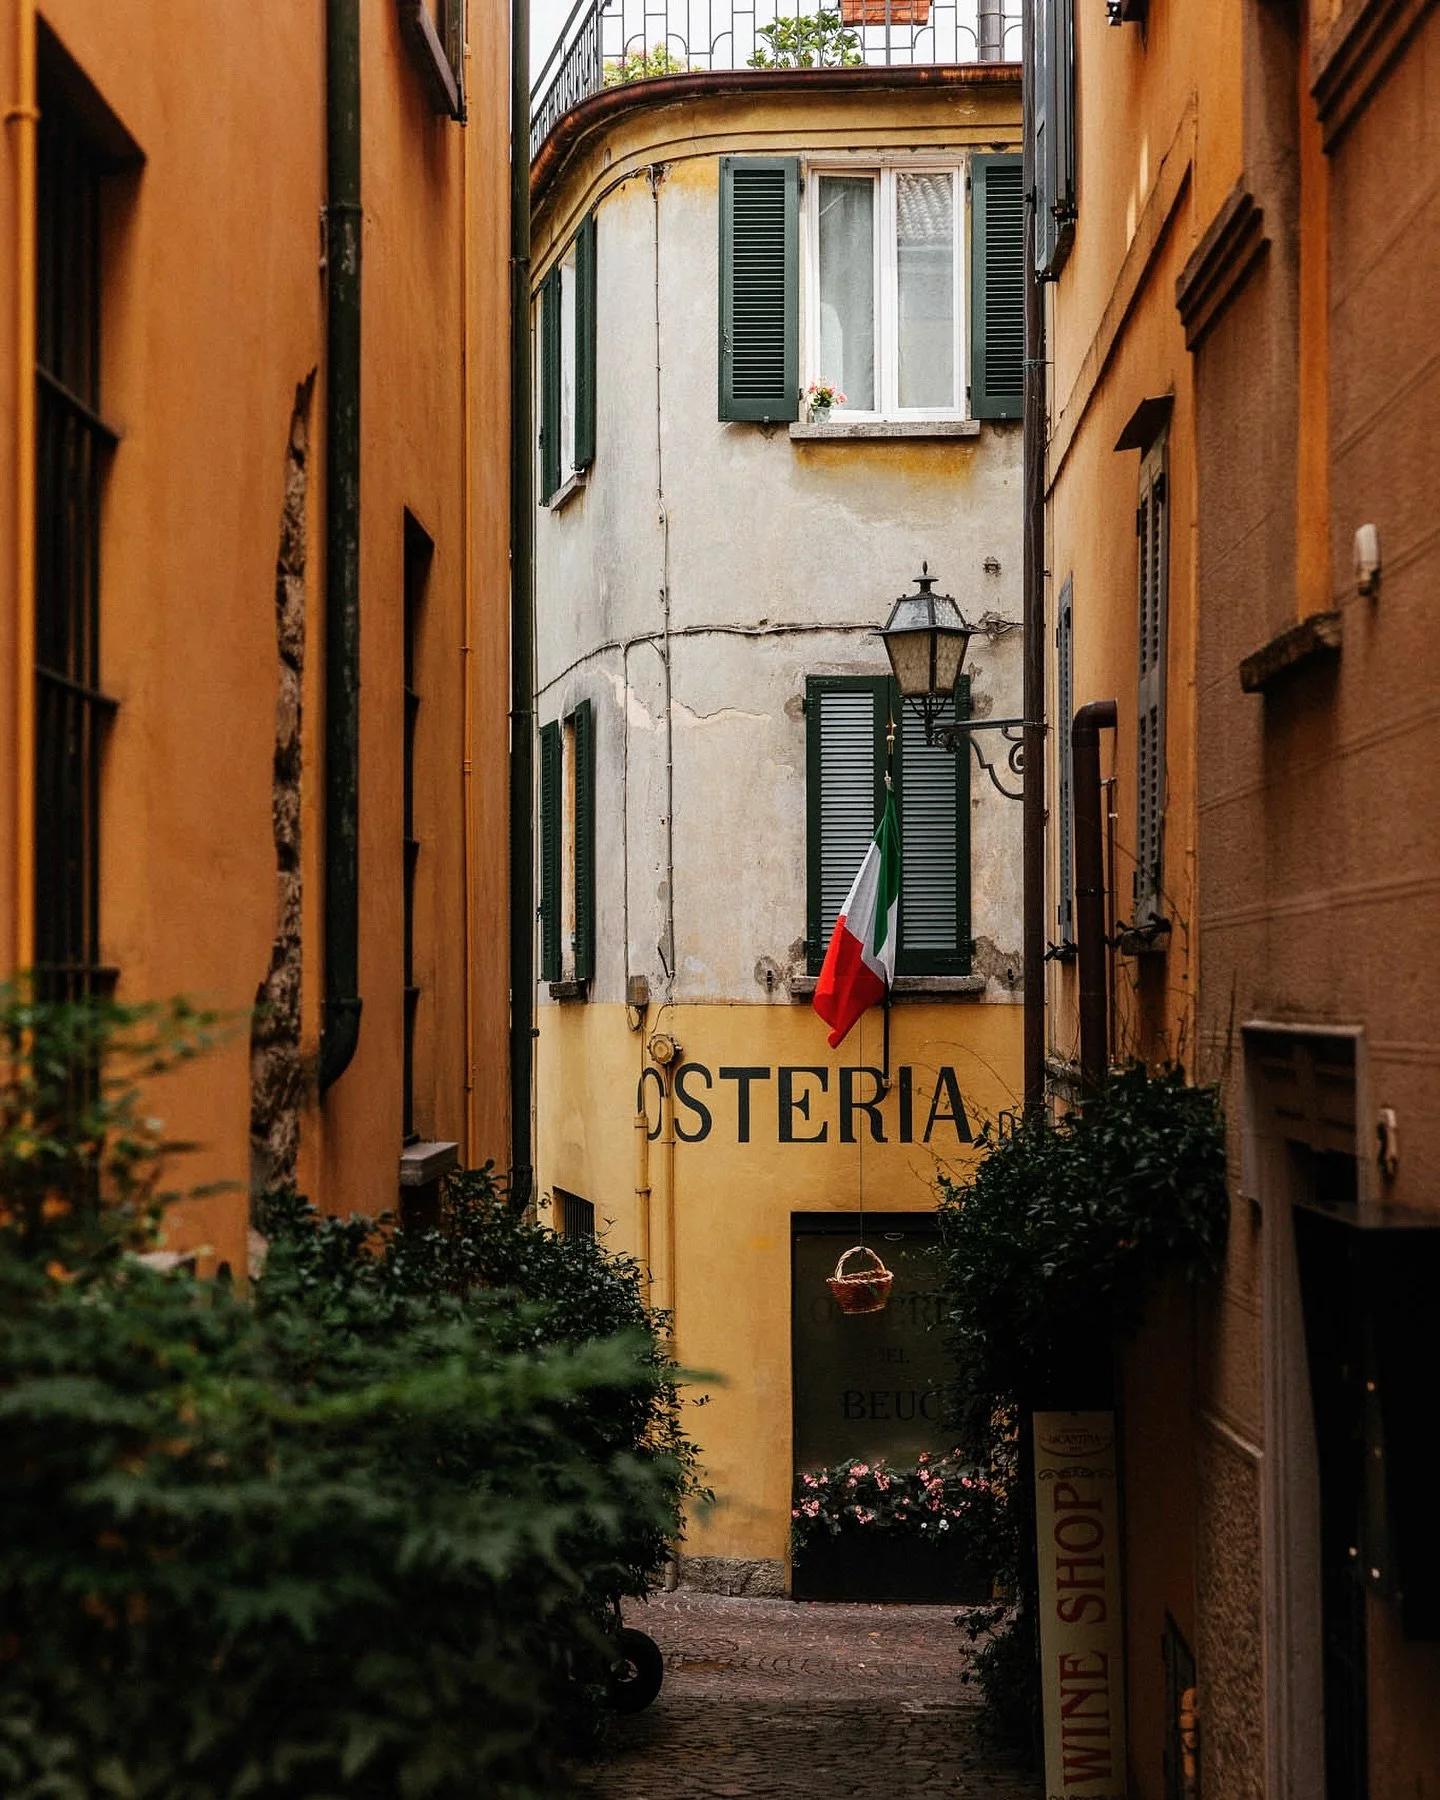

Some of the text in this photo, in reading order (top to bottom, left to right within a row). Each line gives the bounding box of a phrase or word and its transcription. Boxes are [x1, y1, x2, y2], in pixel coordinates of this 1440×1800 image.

[637, 1063, 974, 1144] OSTERIA
[1053, 1481, 1107, 1625] SHOP
[1059, 1649, 1113, 1786] WINE
